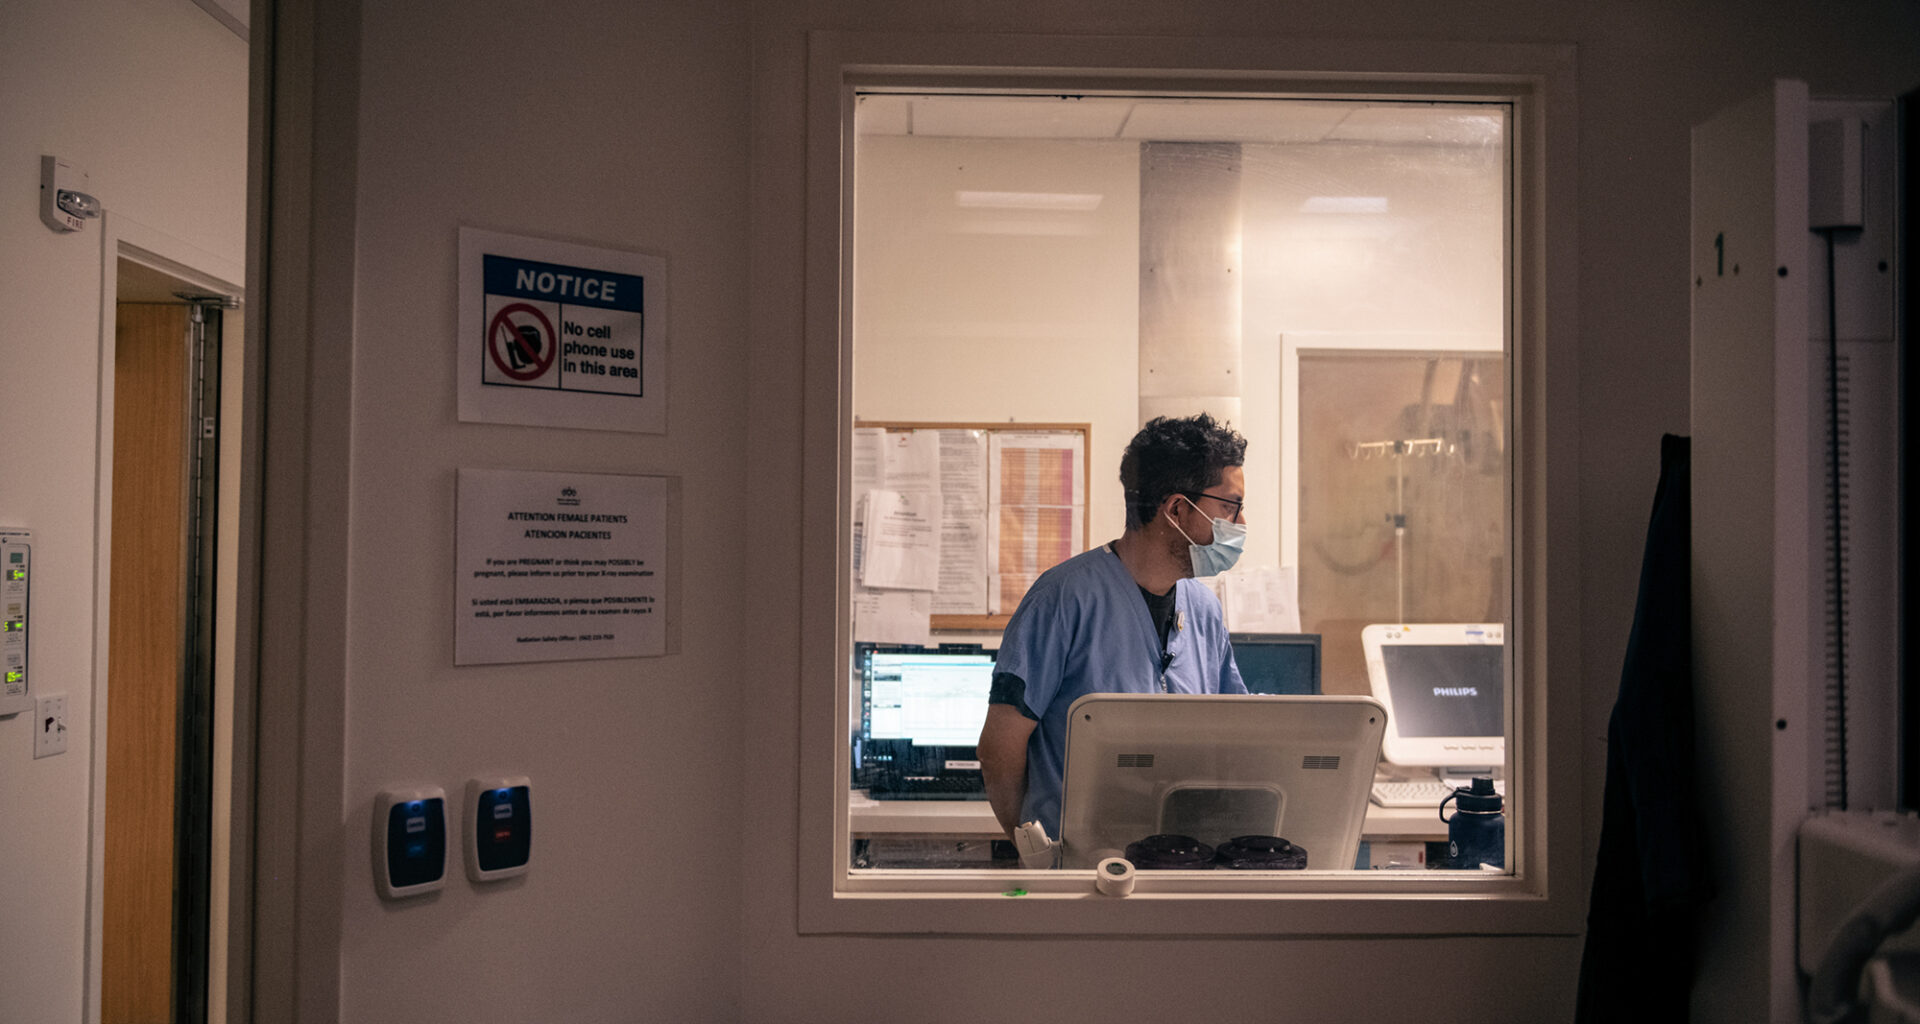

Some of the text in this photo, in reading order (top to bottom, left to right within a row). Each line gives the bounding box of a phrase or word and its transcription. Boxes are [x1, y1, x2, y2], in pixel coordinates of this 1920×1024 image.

[66, 216, 84, 229] FIRE
[1714, 231, 1724, 277] 1
[516, 268, 617, 302] NOTICE
[564, 321, 611, 339] No cell
[564, 341, 635, 360] phone use
[564, 359, 638, 378] in this area
[508, 512, 628, 524] ATTENTION FEMALE PATIENTS
[524, 530, 612, 540] ATENCION PACIENTES
[474, 570, 506, 578] pregnant,
[508, 570, 528, 578] please
[1433, 686, 1478, 696] PHILIPS
